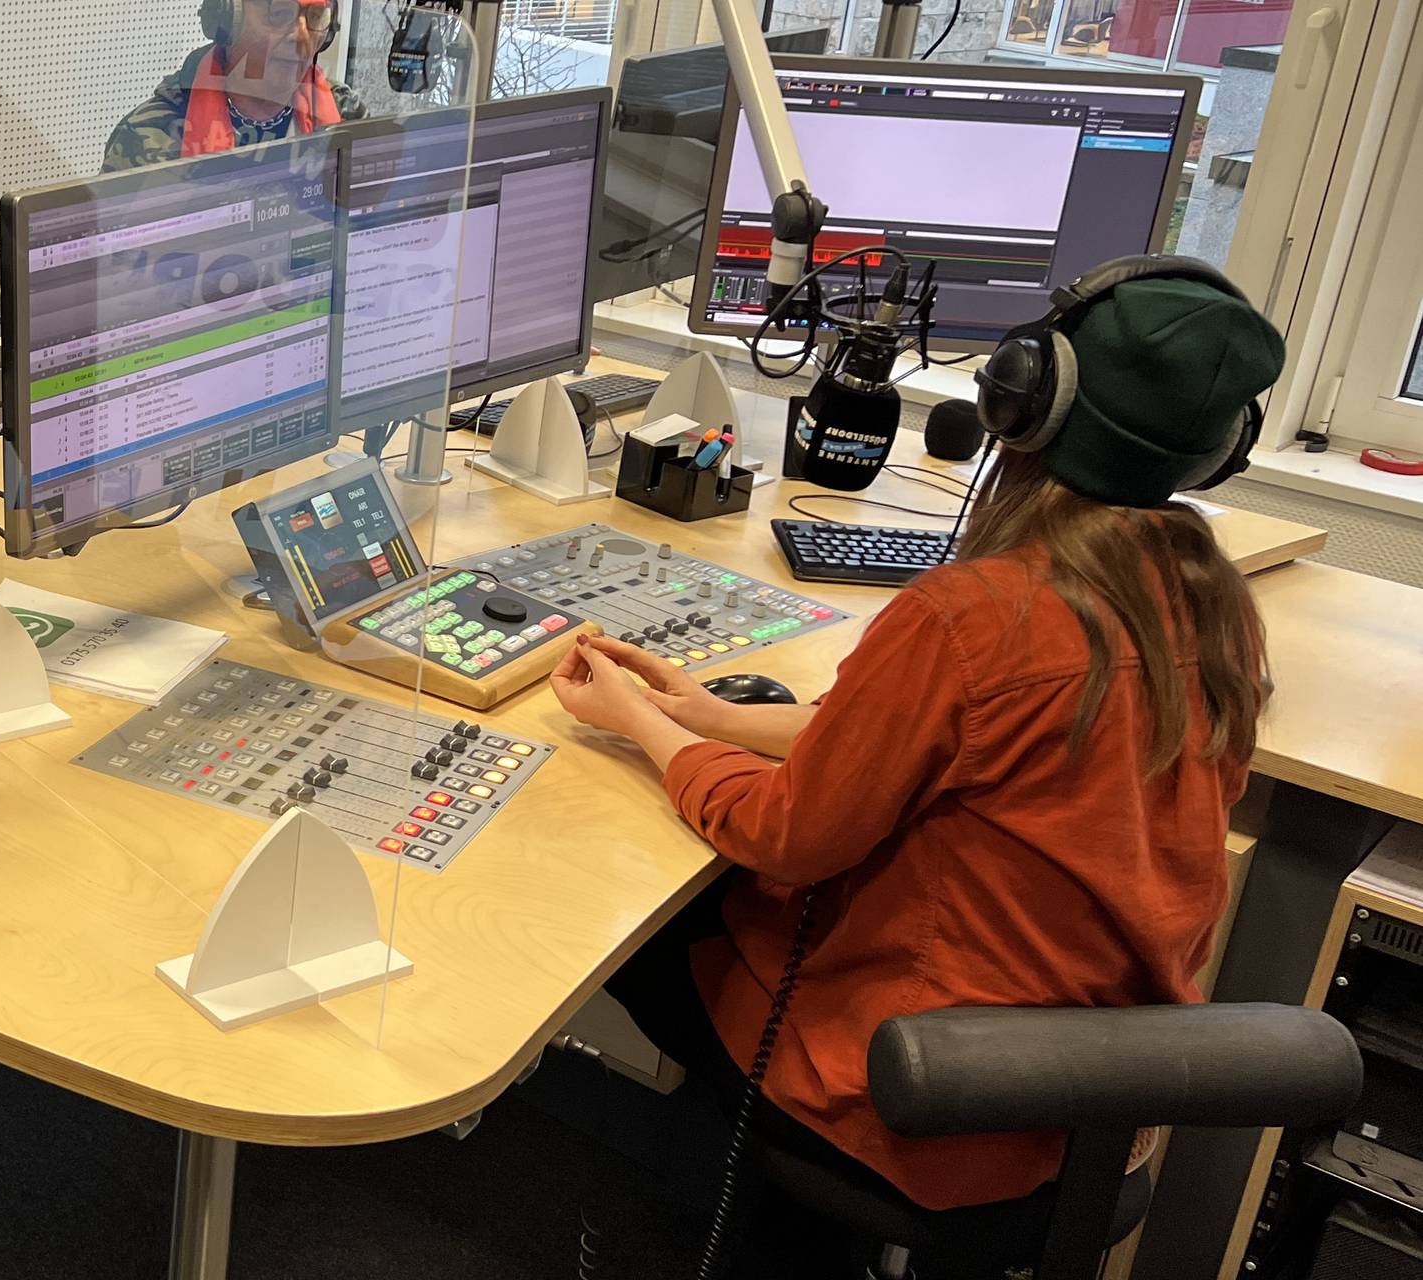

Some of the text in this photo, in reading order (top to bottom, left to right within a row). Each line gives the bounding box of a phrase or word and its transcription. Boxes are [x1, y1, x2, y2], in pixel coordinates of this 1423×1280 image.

[302, 183, 323, 198] 29:00
[257, 204, 290, 222] 10:04:00
[818, 450, 879, 466] ANTENNE
[61, 648, 90, 666] 0175
[82, 636, 106, 649] 570
